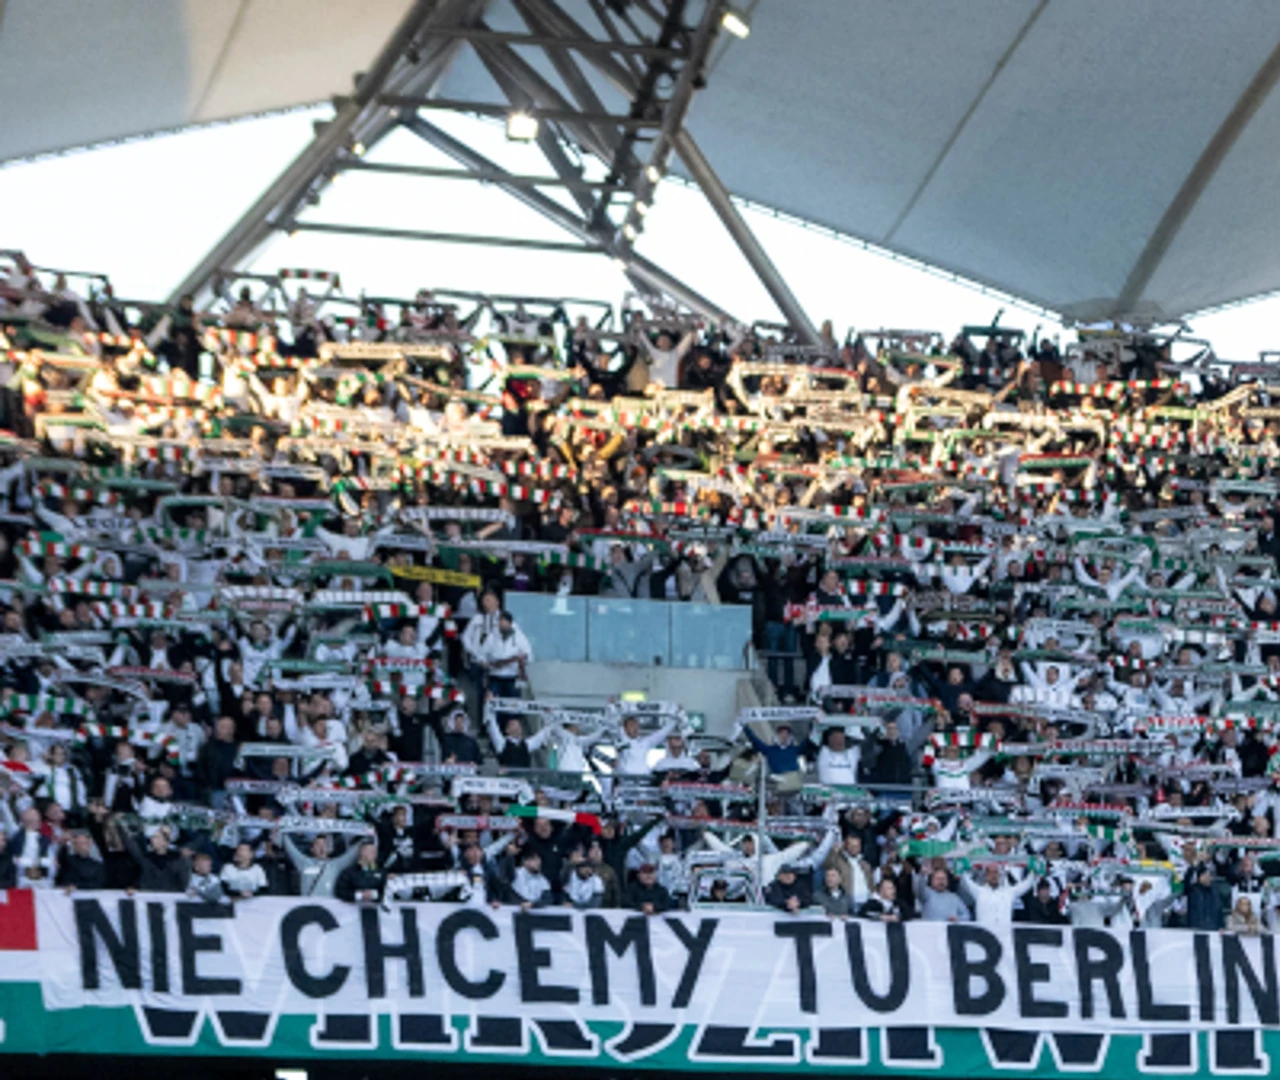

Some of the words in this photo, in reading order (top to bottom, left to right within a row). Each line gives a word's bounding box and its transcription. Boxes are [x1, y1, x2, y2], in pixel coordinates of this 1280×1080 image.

[73, 900, 241, 996] NIE
[280, 904, 720, 1009] CHCEMY
[774, 920, 911, 1014] TU
